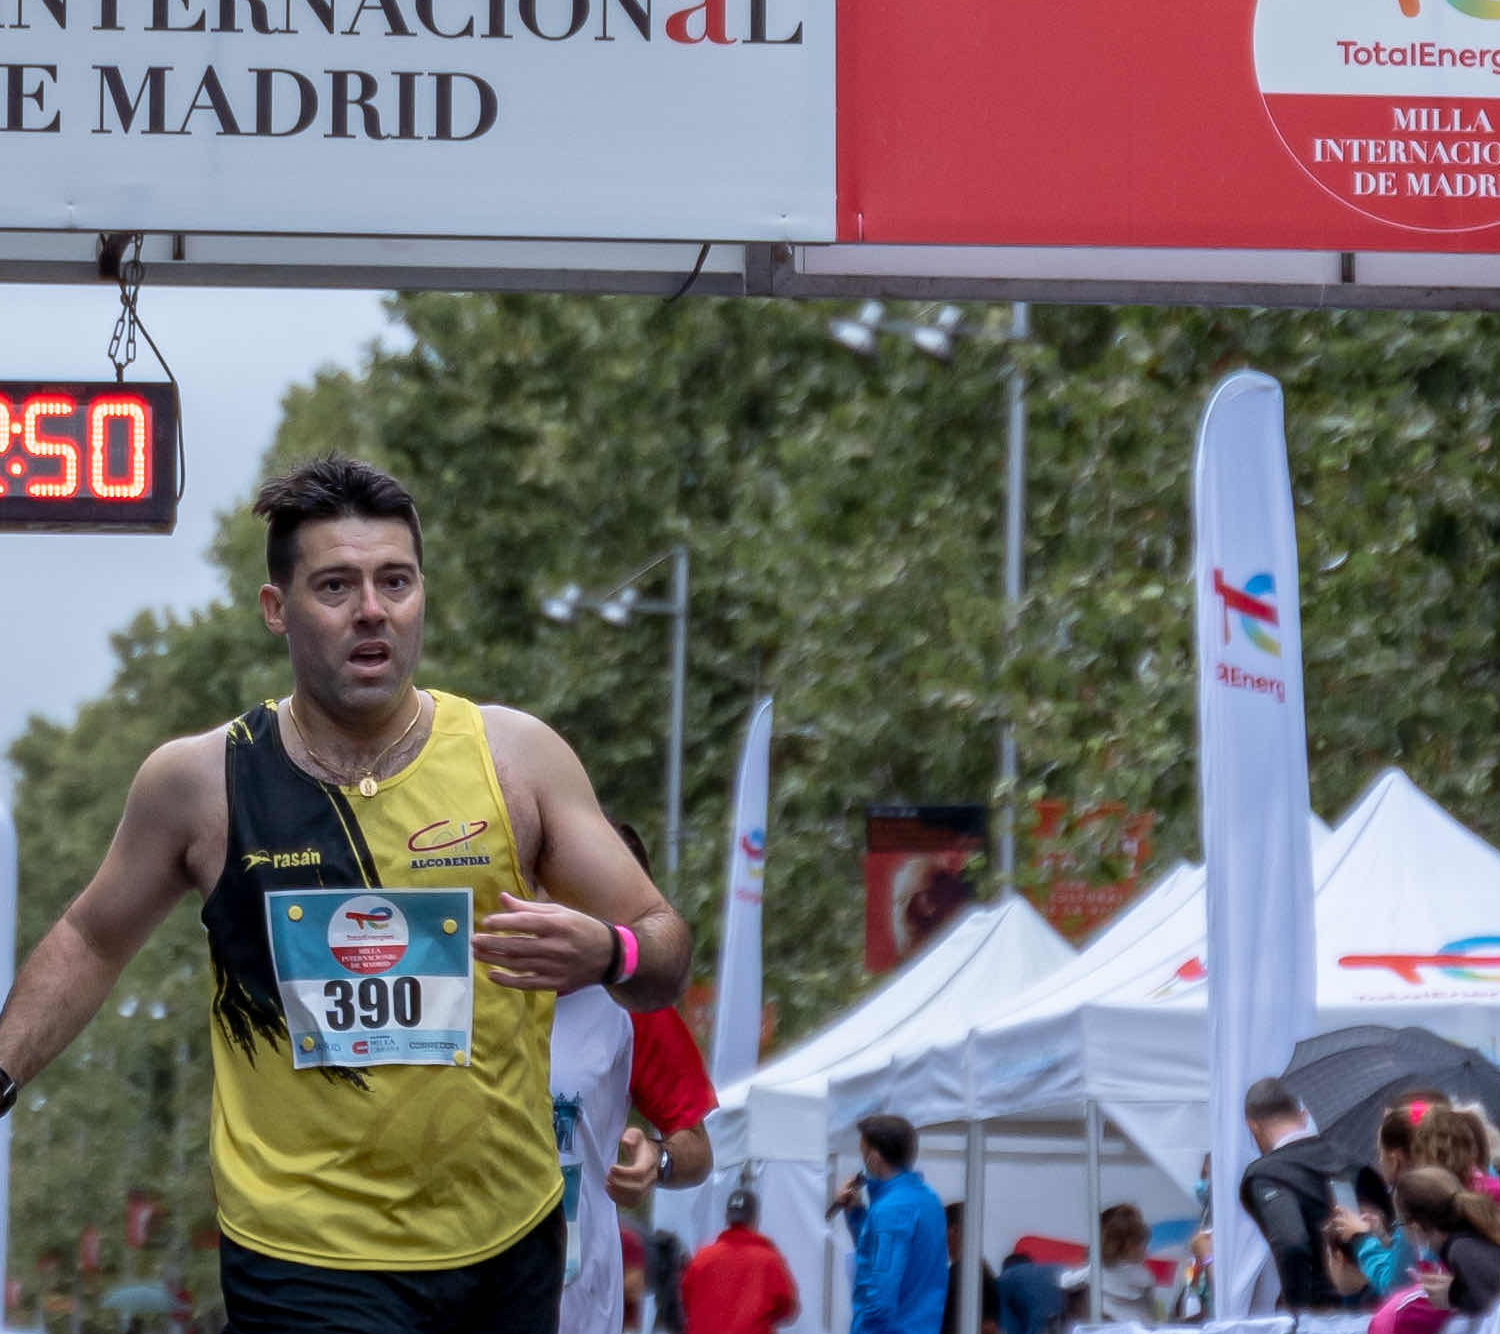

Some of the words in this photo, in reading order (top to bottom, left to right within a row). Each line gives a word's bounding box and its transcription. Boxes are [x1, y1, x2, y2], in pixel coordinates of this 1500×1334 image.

[90, 63, 499, 142] MADRID
[1392, 106, 1495, 134] MILLA
[1353, 170, 1398, 197] DE
[409, 855, 490, 869] ALCOBENDAS
[322, 974, 424, 1033] 390
